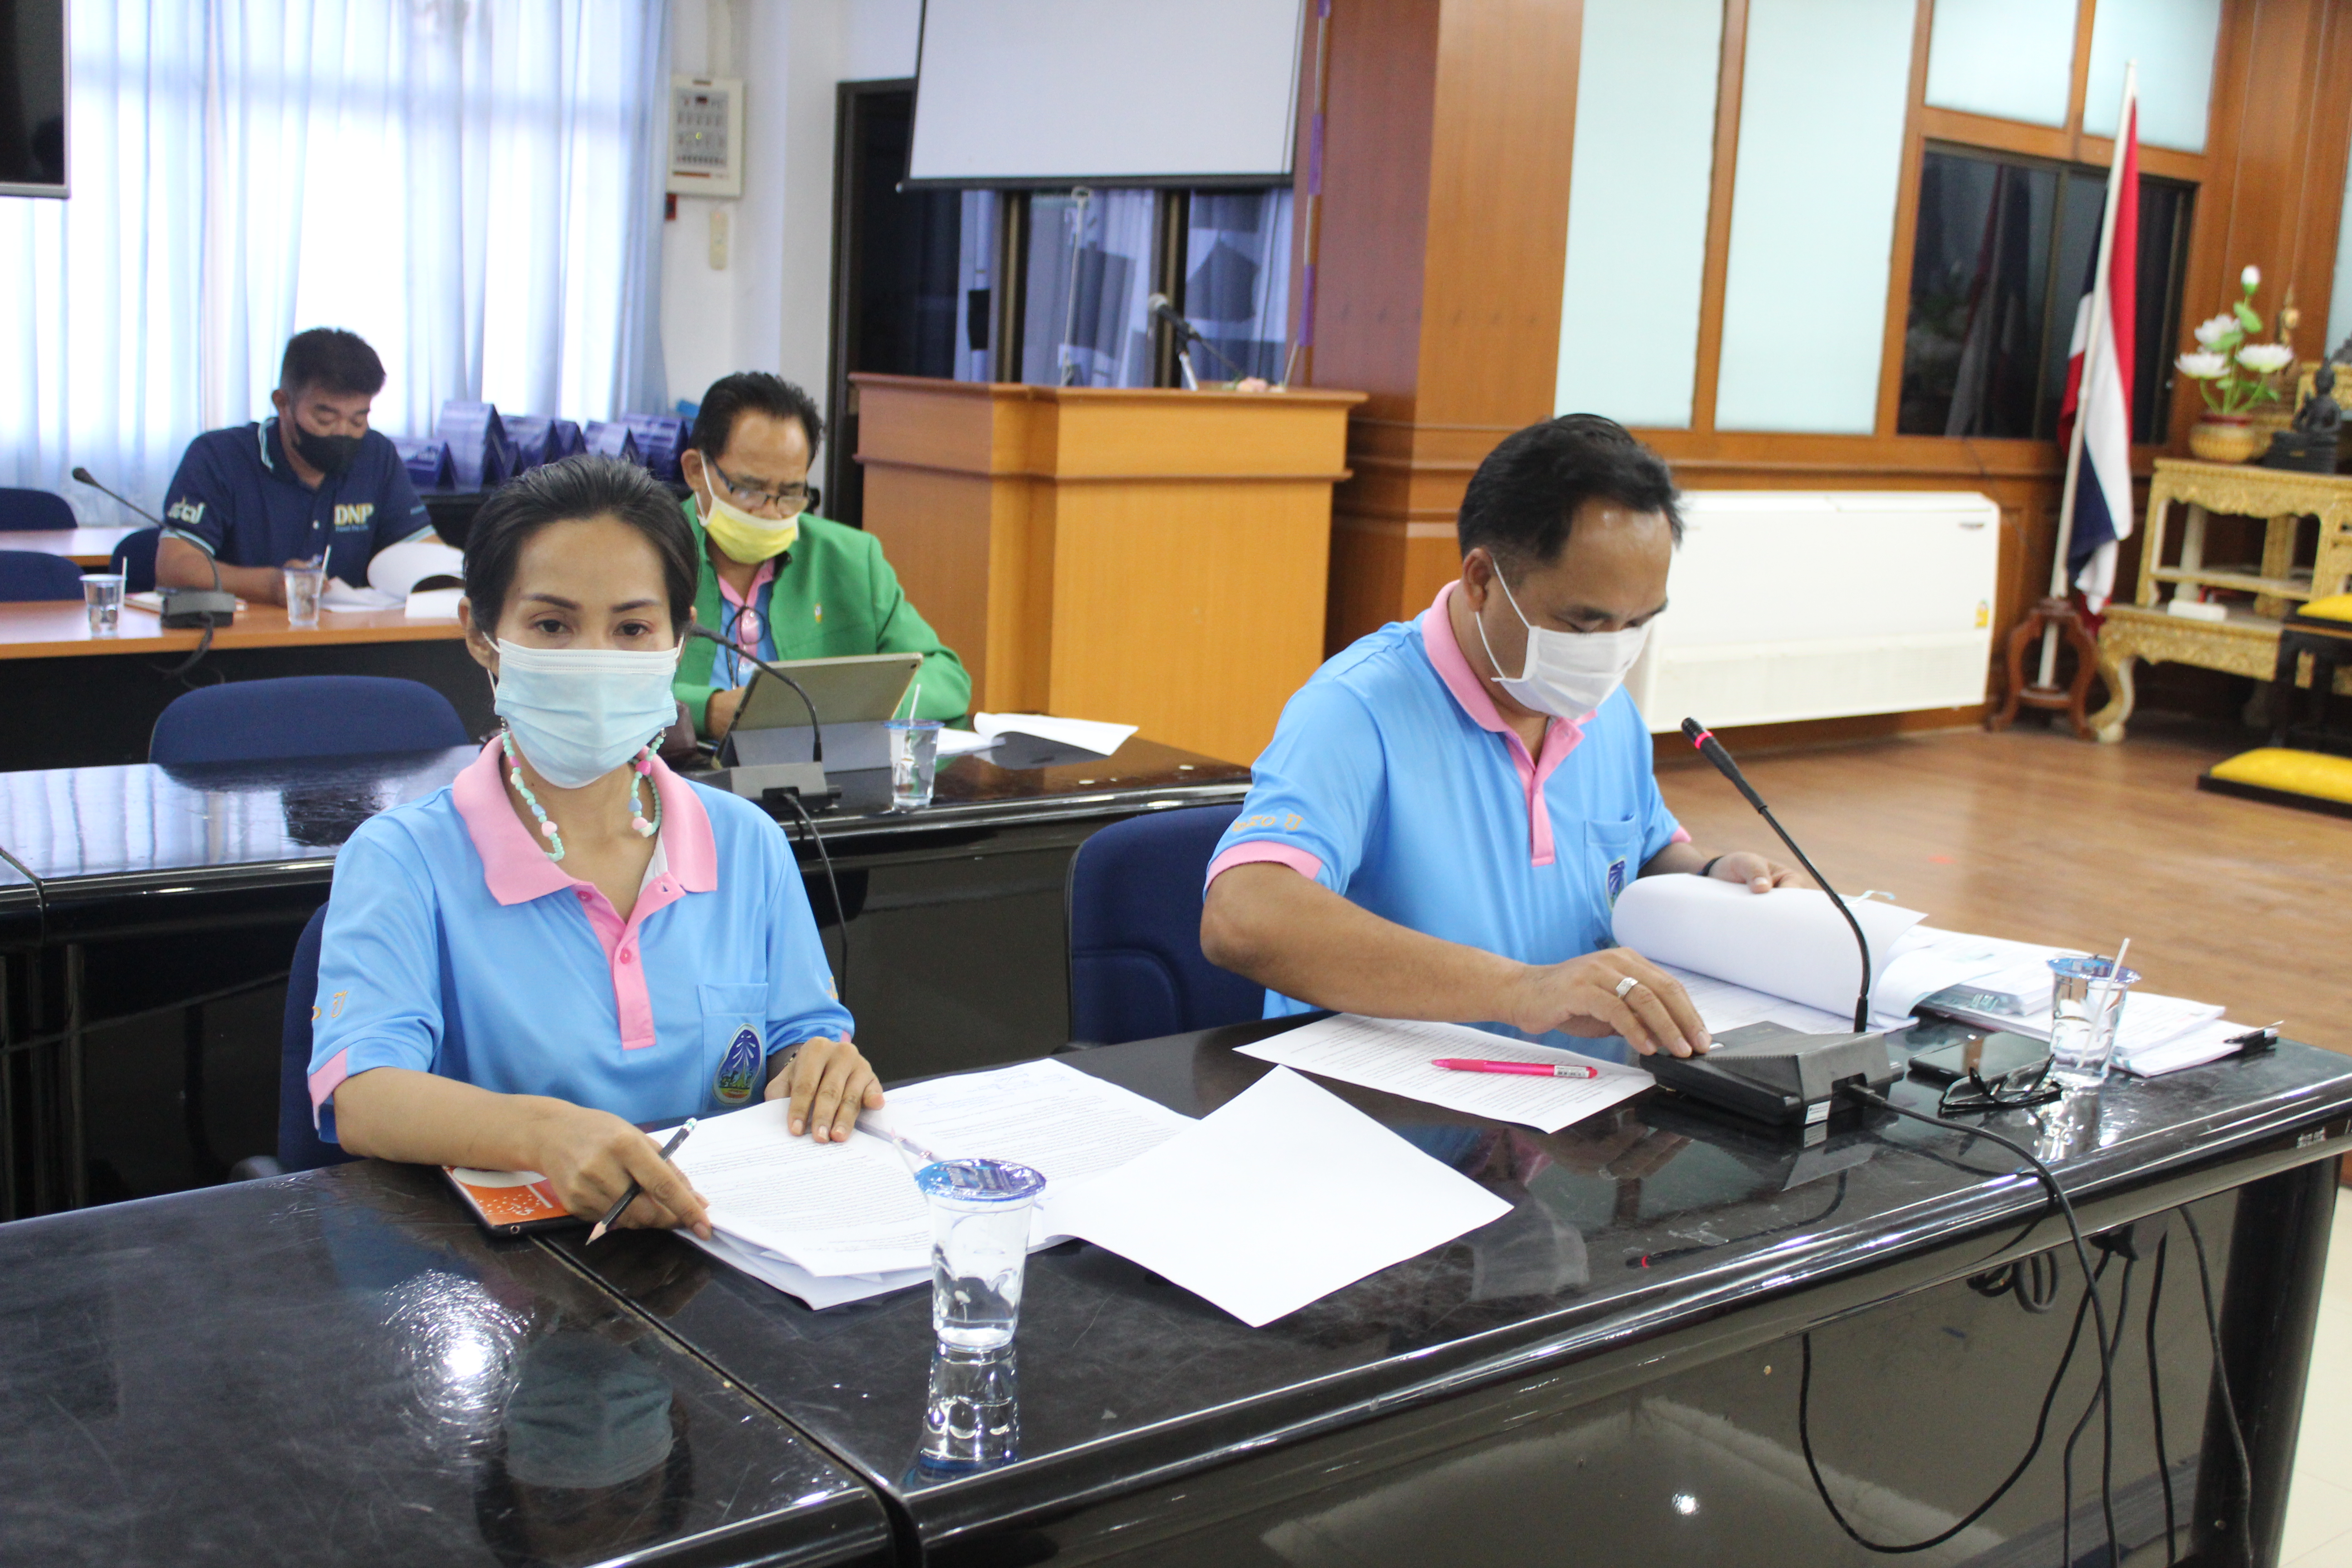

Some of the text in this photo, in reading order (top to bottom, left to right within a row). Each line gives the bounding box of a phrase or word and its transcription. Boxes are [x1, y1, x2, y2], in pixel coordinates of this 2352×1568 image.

[334, 503, 375, 526] DNP
[1284, 813, 1304, 831] ปี
[331, 990, 348, 1018] ปี
